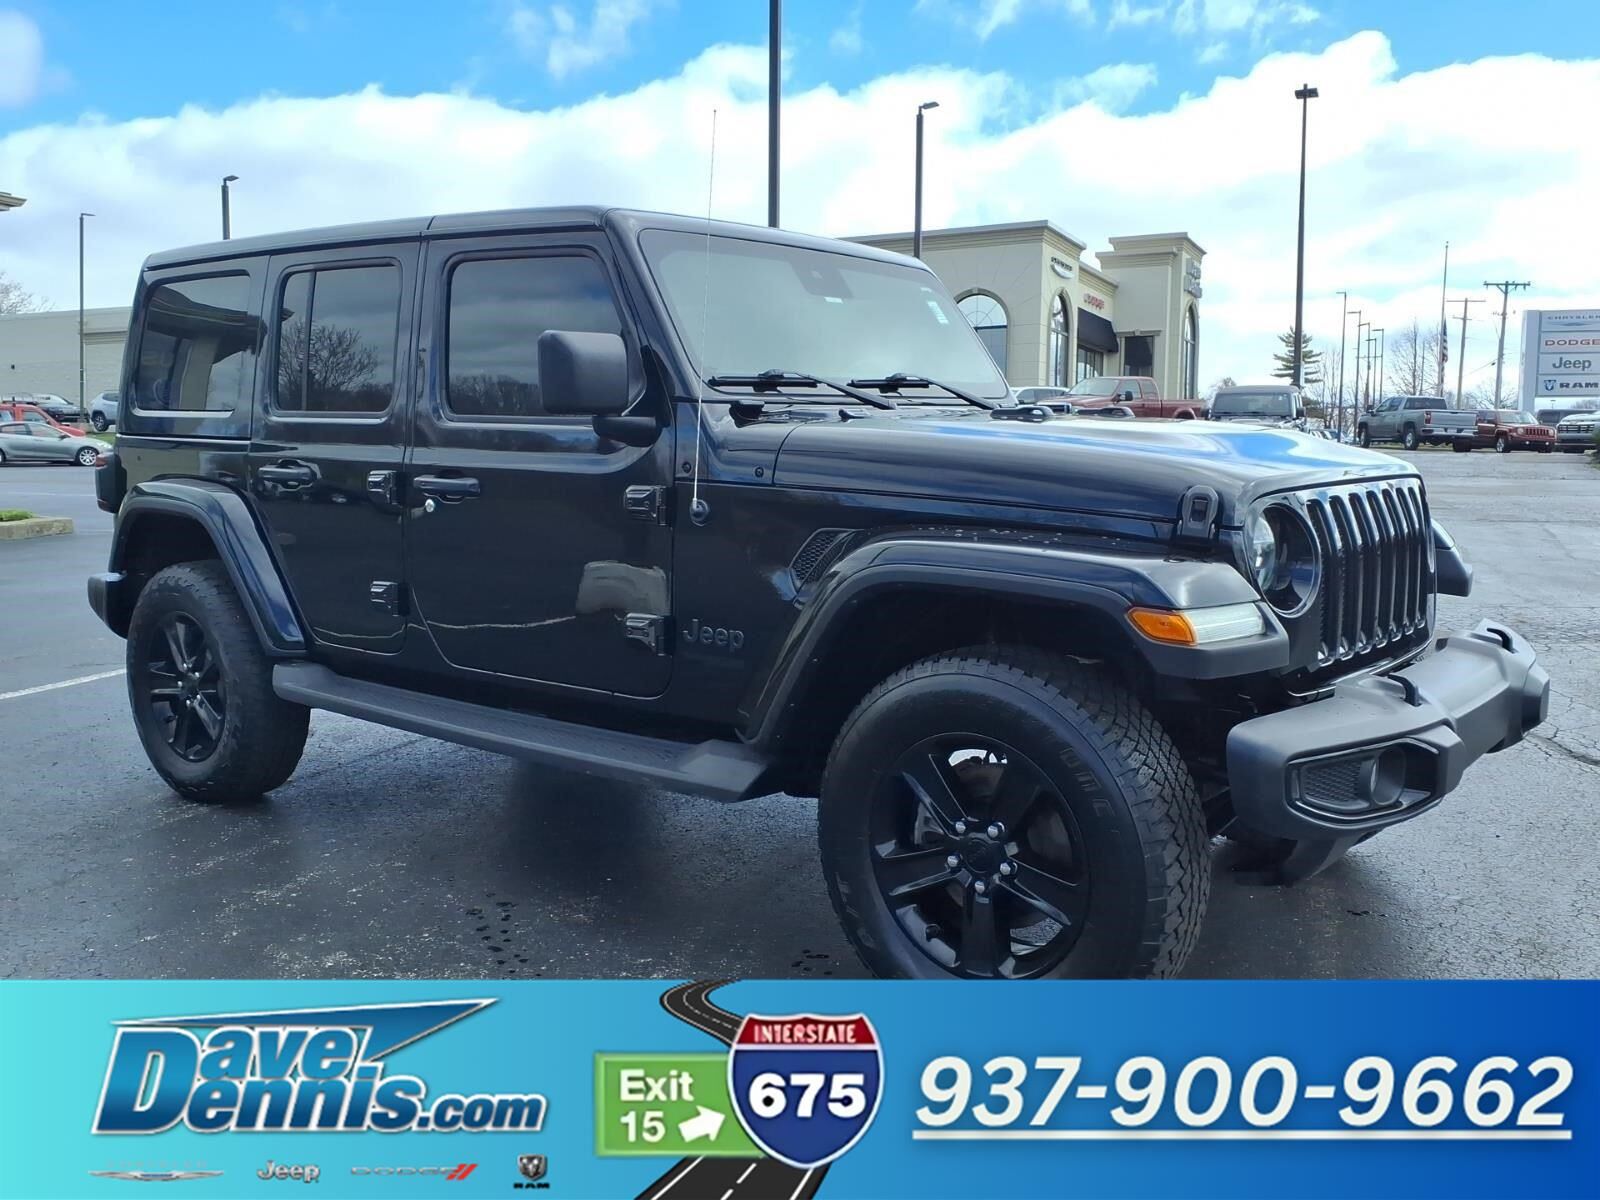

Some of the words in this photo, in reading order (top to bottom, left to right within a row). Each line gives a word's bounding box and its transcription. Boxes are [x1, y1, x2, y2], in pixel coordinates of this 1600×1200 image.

[1545, 338, 1600, 346] DODGE
[1552, 357, 1592, 371] Jeep
[682, 618, 745, 653] Jeep
